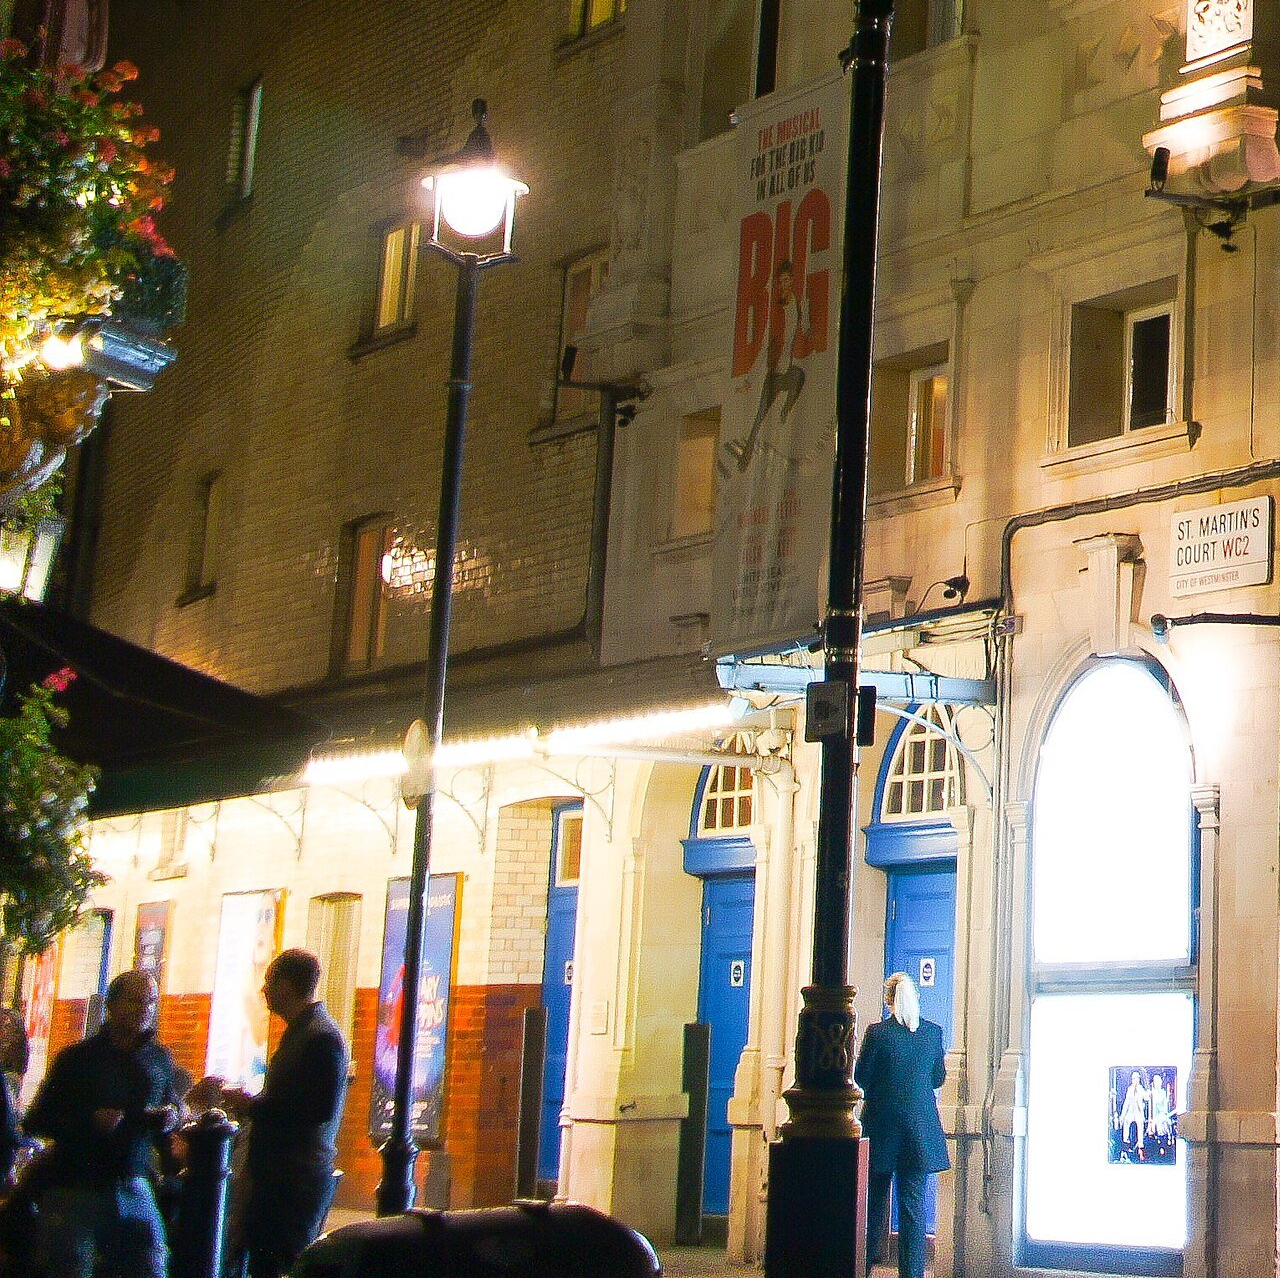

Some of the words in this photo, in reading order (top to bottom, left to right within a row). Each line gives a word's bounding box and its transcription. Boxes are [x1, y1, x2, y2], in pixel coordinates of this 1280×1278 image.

[759, 124, 773, 152] THE
[731, 188, 832, 378] BIG
[1178, 520, 1194, 540] ST.
[1200, 508, 1260, 537] MARTIN'S
[1177, 541, 1217, 567] COURT
[1223, 536, 1250, 559] WC2
[1176, 579, 1189, 590] CITY
[1190, 577, 1198, 588] OF
[1199, 570, 1240, 586] WESTMINSTER
